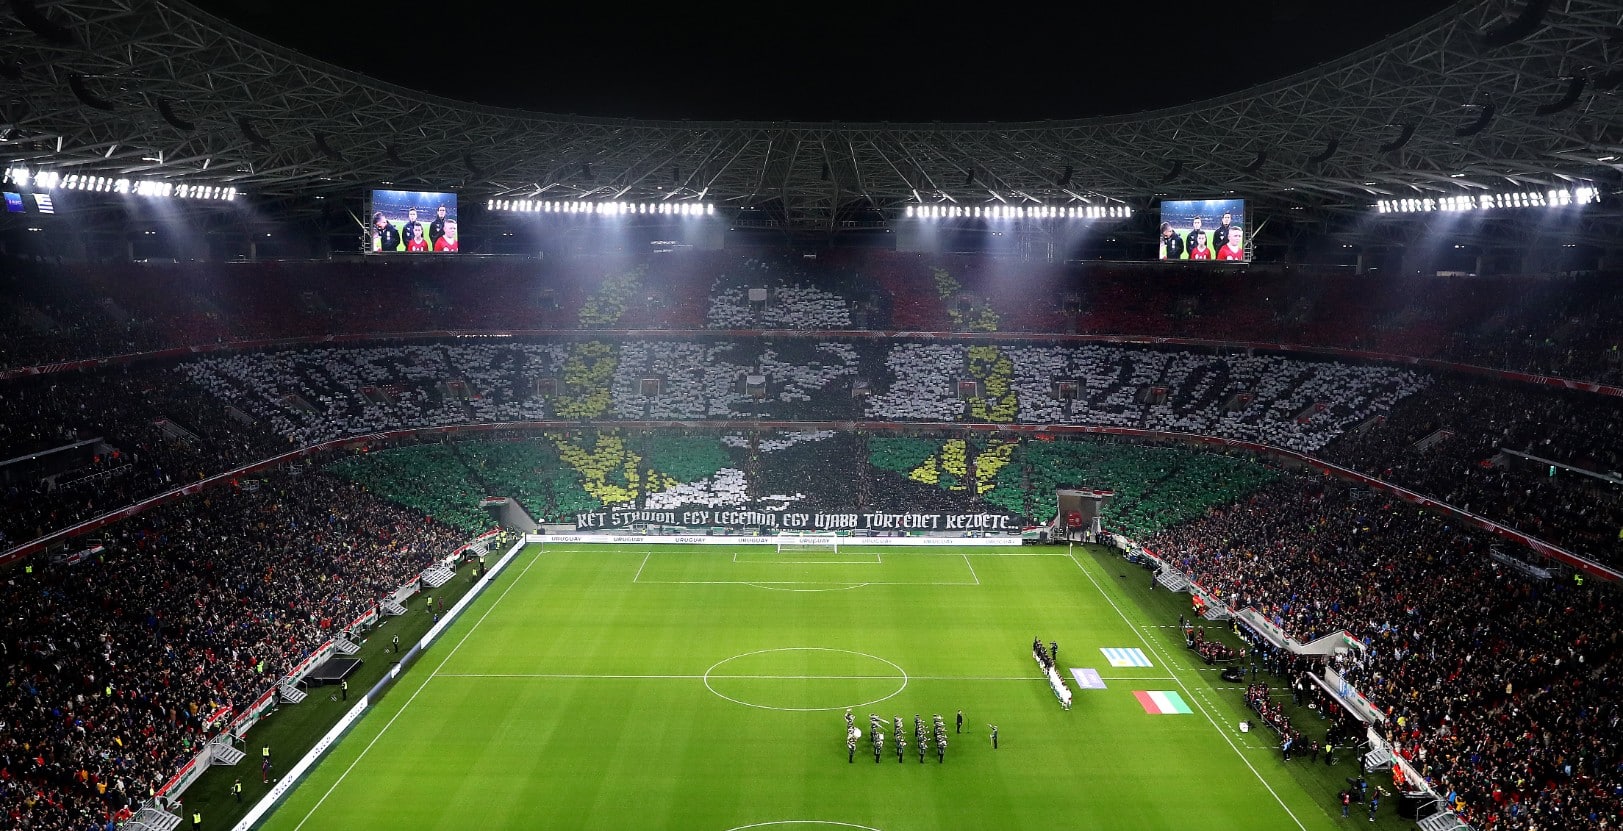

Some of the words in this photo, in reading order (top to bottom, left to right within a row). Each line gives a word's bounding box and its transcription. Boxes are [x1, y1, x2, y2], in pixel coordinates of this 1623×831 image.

[577, 510, 607, 529] KÉT
[684, 512, 710, 525] EGY
[715, 511, 780, 528] LEGENDA,
[783, 513, 810, 527] EGY
[815, 510, 858, 530] ÚJABB
[864, 511, 941, 528] TÖRTÉNET
